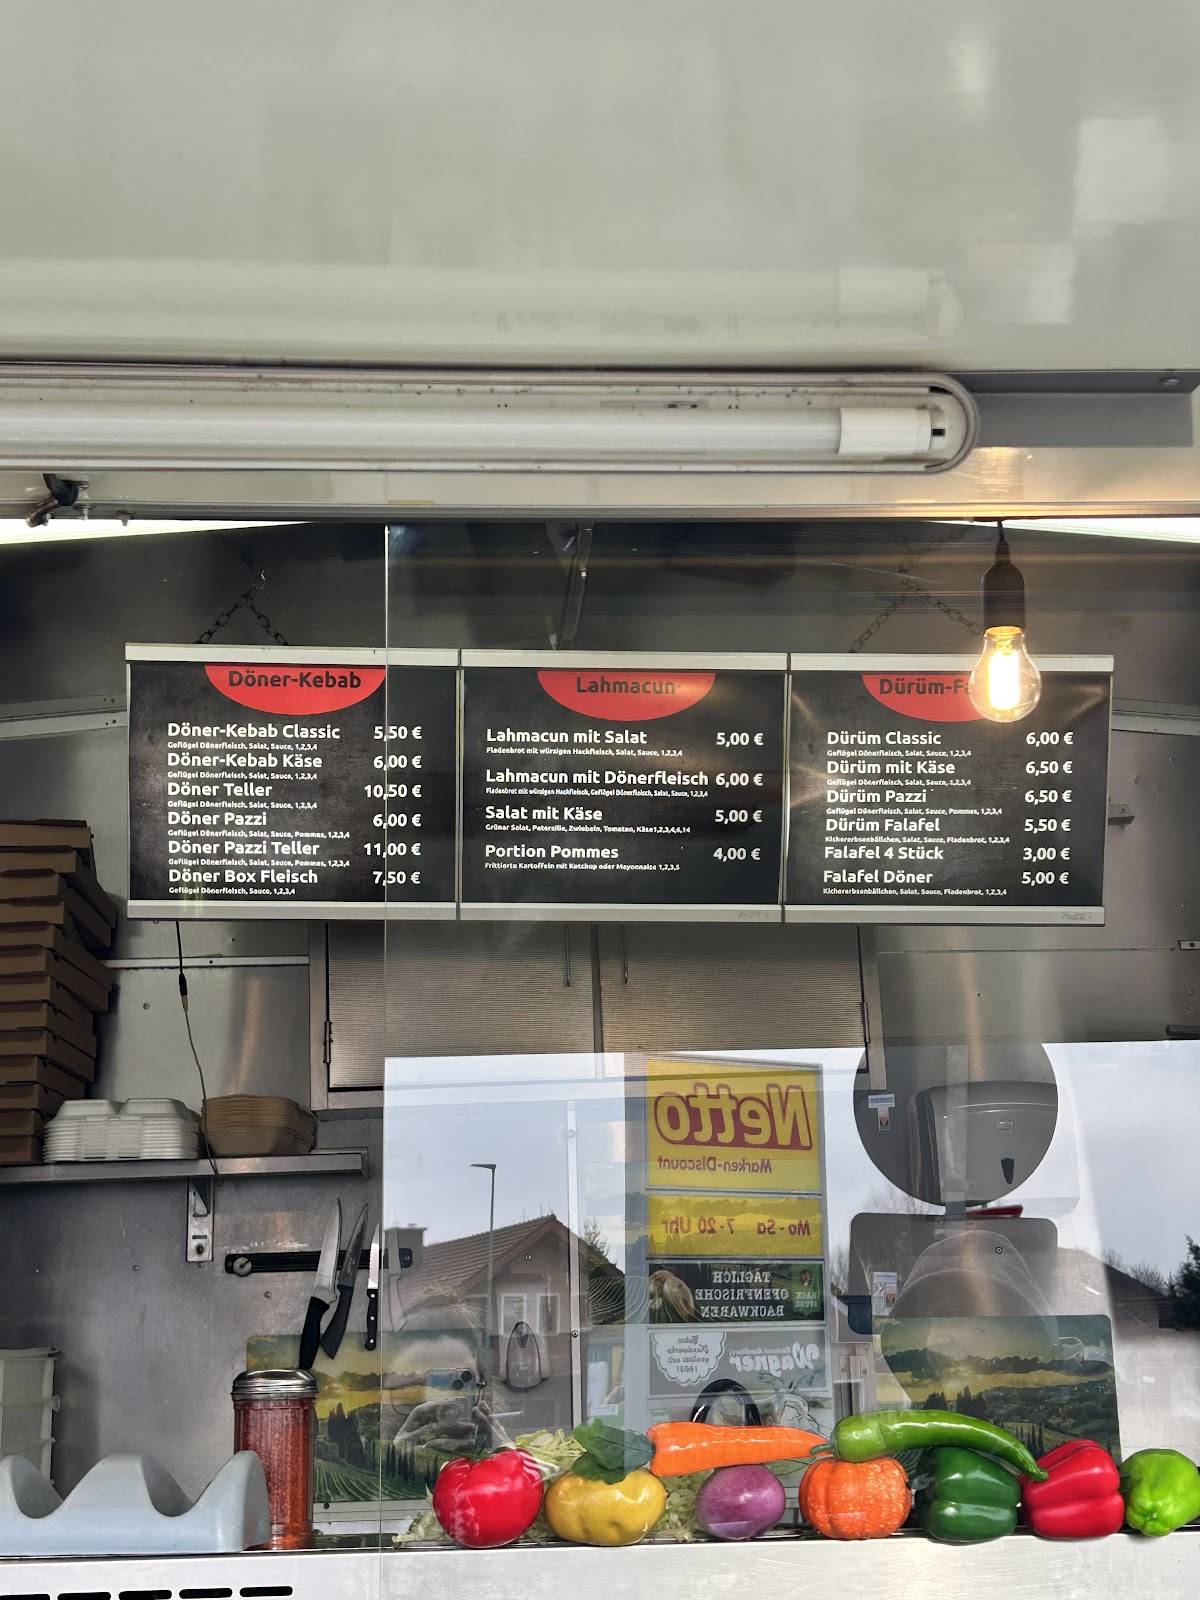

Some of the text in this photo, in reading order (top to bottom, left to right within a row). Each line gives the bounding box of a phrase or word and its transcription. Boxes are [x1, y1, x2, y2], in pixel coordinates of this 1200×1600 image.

[229, 670, 361, 688] Döner-Kebab
[576, 676, 676, 695] Lahmacun
[168, 722, 422, 742] Döner-Kebab Classic 5,50 €
[487, 728, 764, 748] Lahmacun mit Salat 5,00 €
[827, 731, 1073, 747] Dürüm Classic 6,00 €
[168, 752, 422, 771] Döner-Kebab Käse 6,00 €
[827, 760, 1073, 776] Dürüm mit Käse 6,50 €
[486, 768, 763, 788] Lahmacun mit Dönerfleisch 6,00 €
[168, 781, 422, 801] Döner Teller 10,50 €
[827, 789, 1072, 805] Dürüm Pazzi 6,50 €
[168, 810, 421, 830] Döner Pazzi 6,00 €
[485, 805, 762, 824] Salat mit Käse 5,00 €
[826, 818, 1071, 834] Dürüm Falafel 5,50 €
[168, 840, 421, 859] Döner Pazzi Teller 11,00 €
[486, 844, 760, 862] Portion Pommes 4,00 €
[825, 845, 1070, 862] Falafel 4 Stück 3,00 €
[169, 868, 421, 887] Döner Box Fleisch 7,50 €
[824, 869, 1069, 886] Falafel Döner 5,00 €
